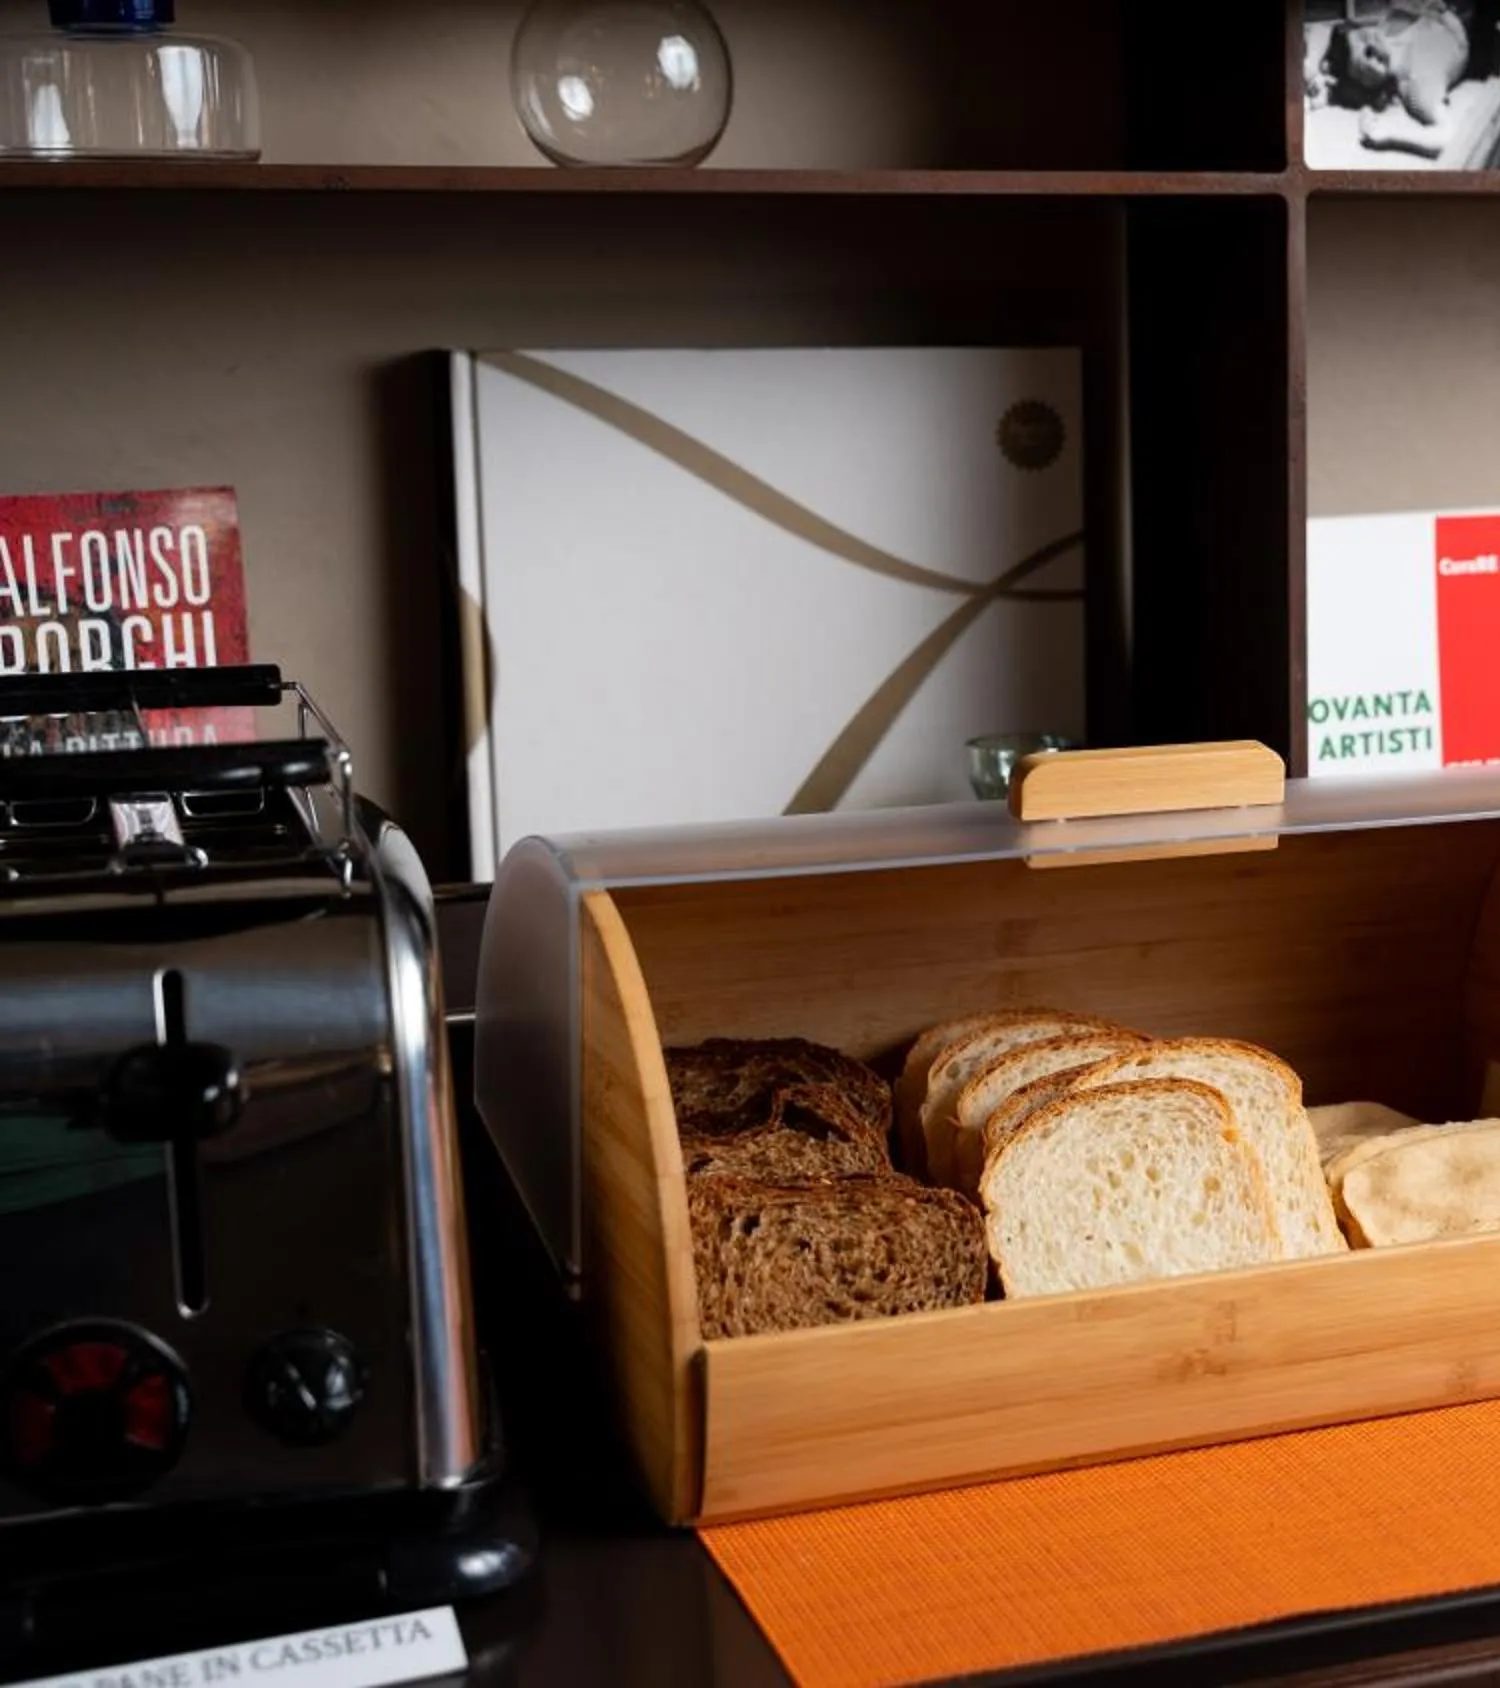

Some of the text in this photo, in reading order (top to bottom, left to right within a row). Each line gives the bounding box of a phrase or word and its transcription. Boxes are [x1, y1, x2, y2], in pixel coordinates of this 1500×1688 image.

[0, 525, 212, 617] ALFONSO
[1318, 727, 1433, 761] ARTISTI
[202, 1654, 241, 1682] IN
[249, 1618, 432, 1671] CASSETTA
